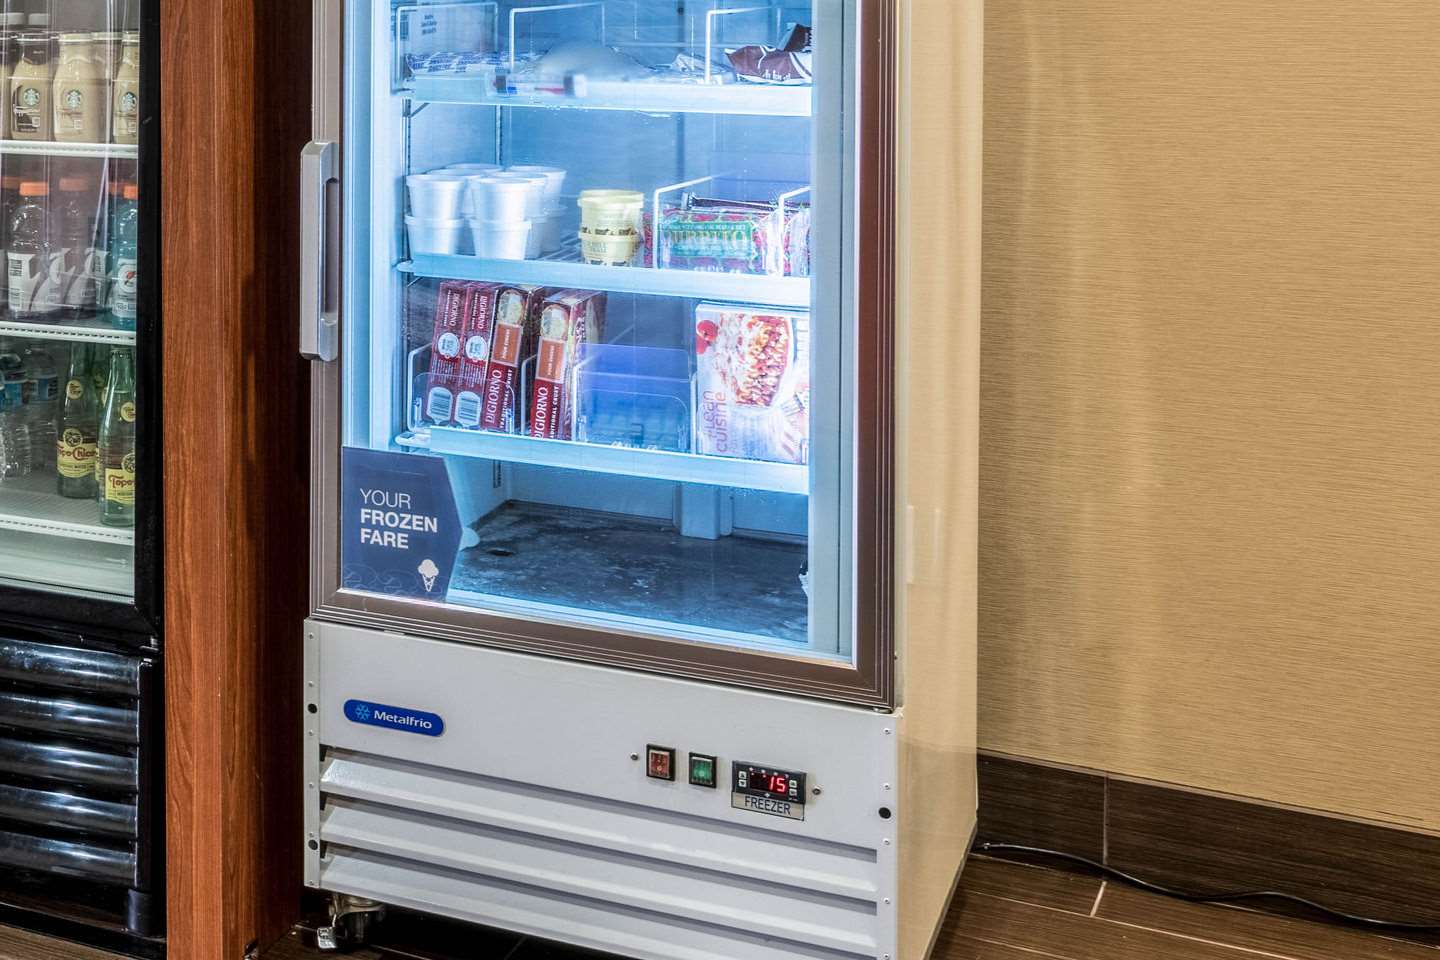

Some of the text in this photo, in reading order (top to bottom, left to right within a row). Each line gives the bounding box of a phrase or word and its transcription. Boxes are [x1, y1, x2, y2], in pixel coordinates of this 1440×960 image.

[485, 369, 503, 425] DIGIORNO
[360, 488, 412, 509] YOUR
[360, 508, 438, 533] FROZEN
[360, 528, 410, 549] FARE
[373, 710, 433, 729] Metalfrio
[768, 776, 787, 793] 15
[745, 795, 792, 816] FREEZER
